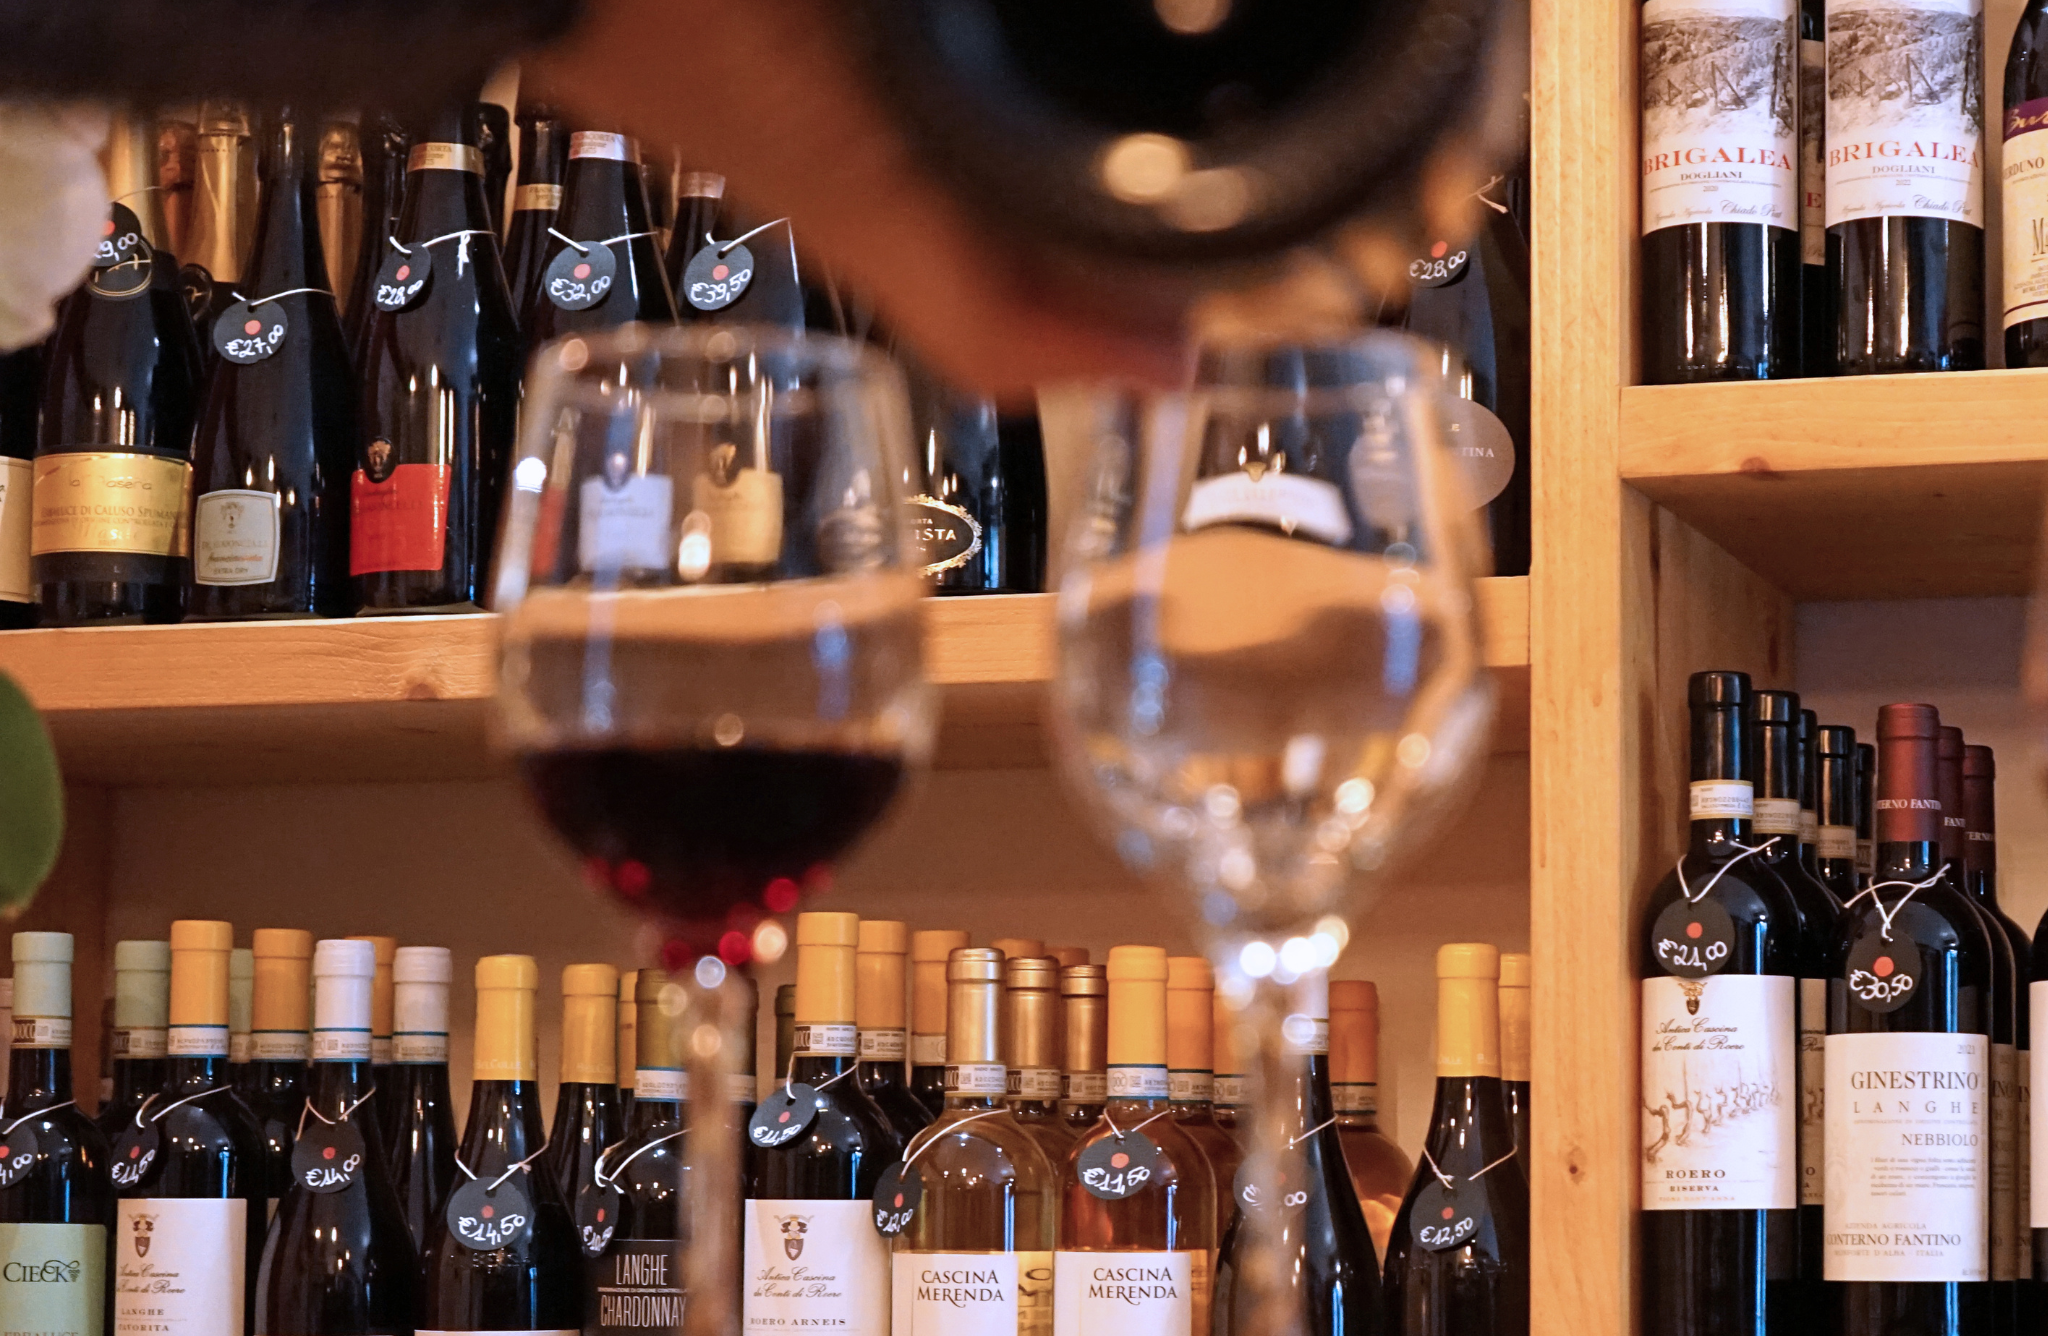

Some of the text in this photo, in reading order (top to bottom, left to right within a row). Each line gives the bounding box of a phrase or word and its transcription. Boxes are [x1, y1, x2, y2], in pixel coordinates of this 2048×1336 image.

[1644, 147, 1792, 176] BRIGALEA
[1829, 140, 1979, 169] BRIGALEA
[1680, 171, 1743, 181] DOGLIANI
[1872, 165, 1936, 174] DOGLIANI
[1409, 250, 1468, 280] €28,00
[376, 279, 424, 305] €28,00
[550, 275, 611, 302] €32,00
[690, 268, 752, 304] €39,50
[224, 324, 285, 357] €27,00
[80, 506, 91, 515] DI
[1658, 938, 1728, 972] €21,00
[1849, 969, 1912, 1002] €30,50
[1656, 1018, 1738, 1034] Antica Cascina
[1663, 1035, 1691, 1052] Conti
[1693, 1039, 1706, 1051] di
[1707, 1035, 1745, 1051] Roero
[1851, 1071, 1979, 1090] GINESTRINO
[1853, 1100, 1979, 1114] LANGHE
[1902, 1134, 1979, 1147] NEBBIOLO
[305, 1153, 361, 1188] €14,00
[1083, 1166, 1150, 1196] €11,50
[1666, 1169, 1726, 1179] ROERO
[457, 1213, 526, 1246] €14,50
[1419, 1217, 1473, 1244] €12,50
[1826, 1234, 1962, 1246] CONTERNO FANTINO
[3, 1260, 81, 1283] CIECK
[616, 1254, 669, 1286] LANGHE
[757, 1266, 836, 1281] Antica Cascina
[921, 1270, 1001, 1285] CASCINA
[1093, 1267, 1173, 1283] CASCINA
[764, 1283, 791, 1298] Conti
[792, 1287, 804, 1297] di
[805, 1283, 842, 1298] Roero
[917, 1286, 1005, 1308] MERENDA
[1088, 1284, 1178, 1306] MERENDA
[121, 1307, 165, 1316] LANGHE
[601, 1295, 687, 1328] CHARDONNAY
[750, 1318, 846, 1326] ROERO ARNEIS
